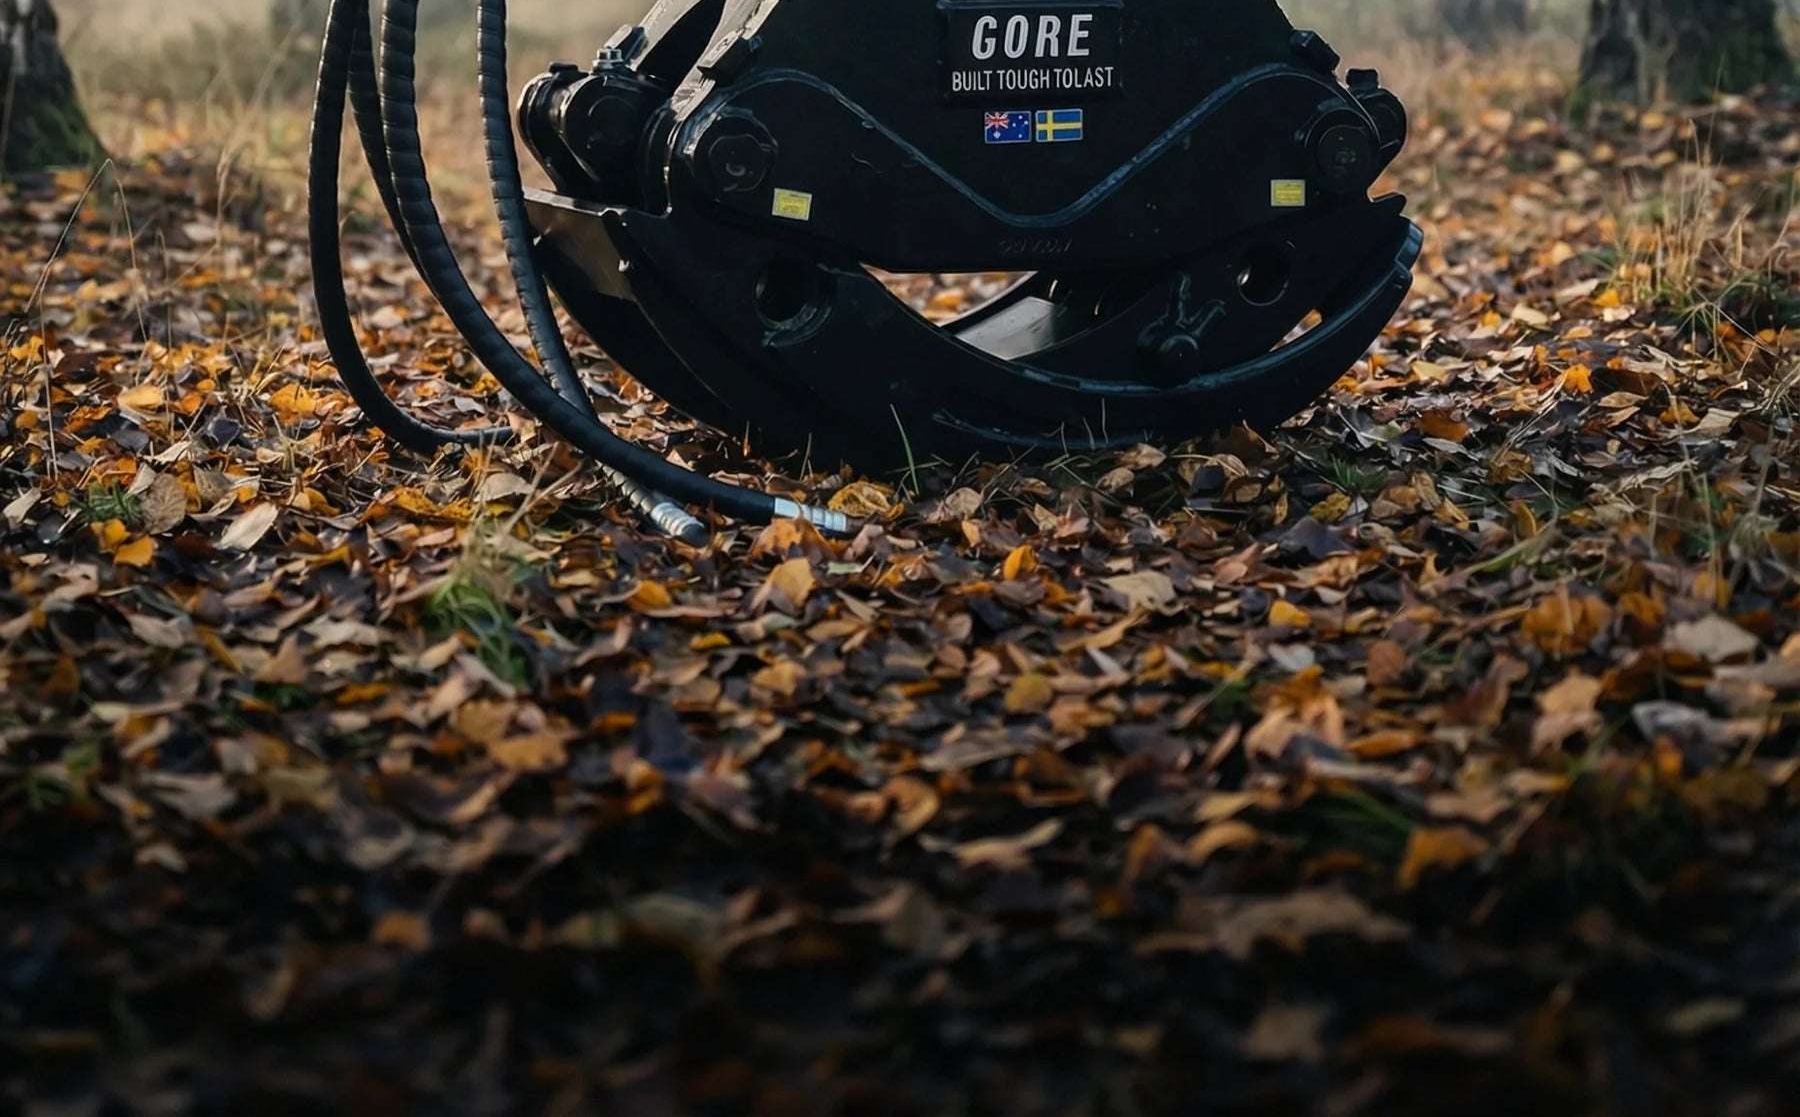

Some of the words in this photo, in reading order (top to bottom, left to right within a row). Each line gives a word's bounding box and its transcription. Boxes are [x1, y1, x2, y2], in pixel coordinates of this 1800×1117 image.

[972, 14, 1093, 59] GORE
[952, 70, 993, 92] BUILT
[997, 68, 1050, 90] TOUGH
